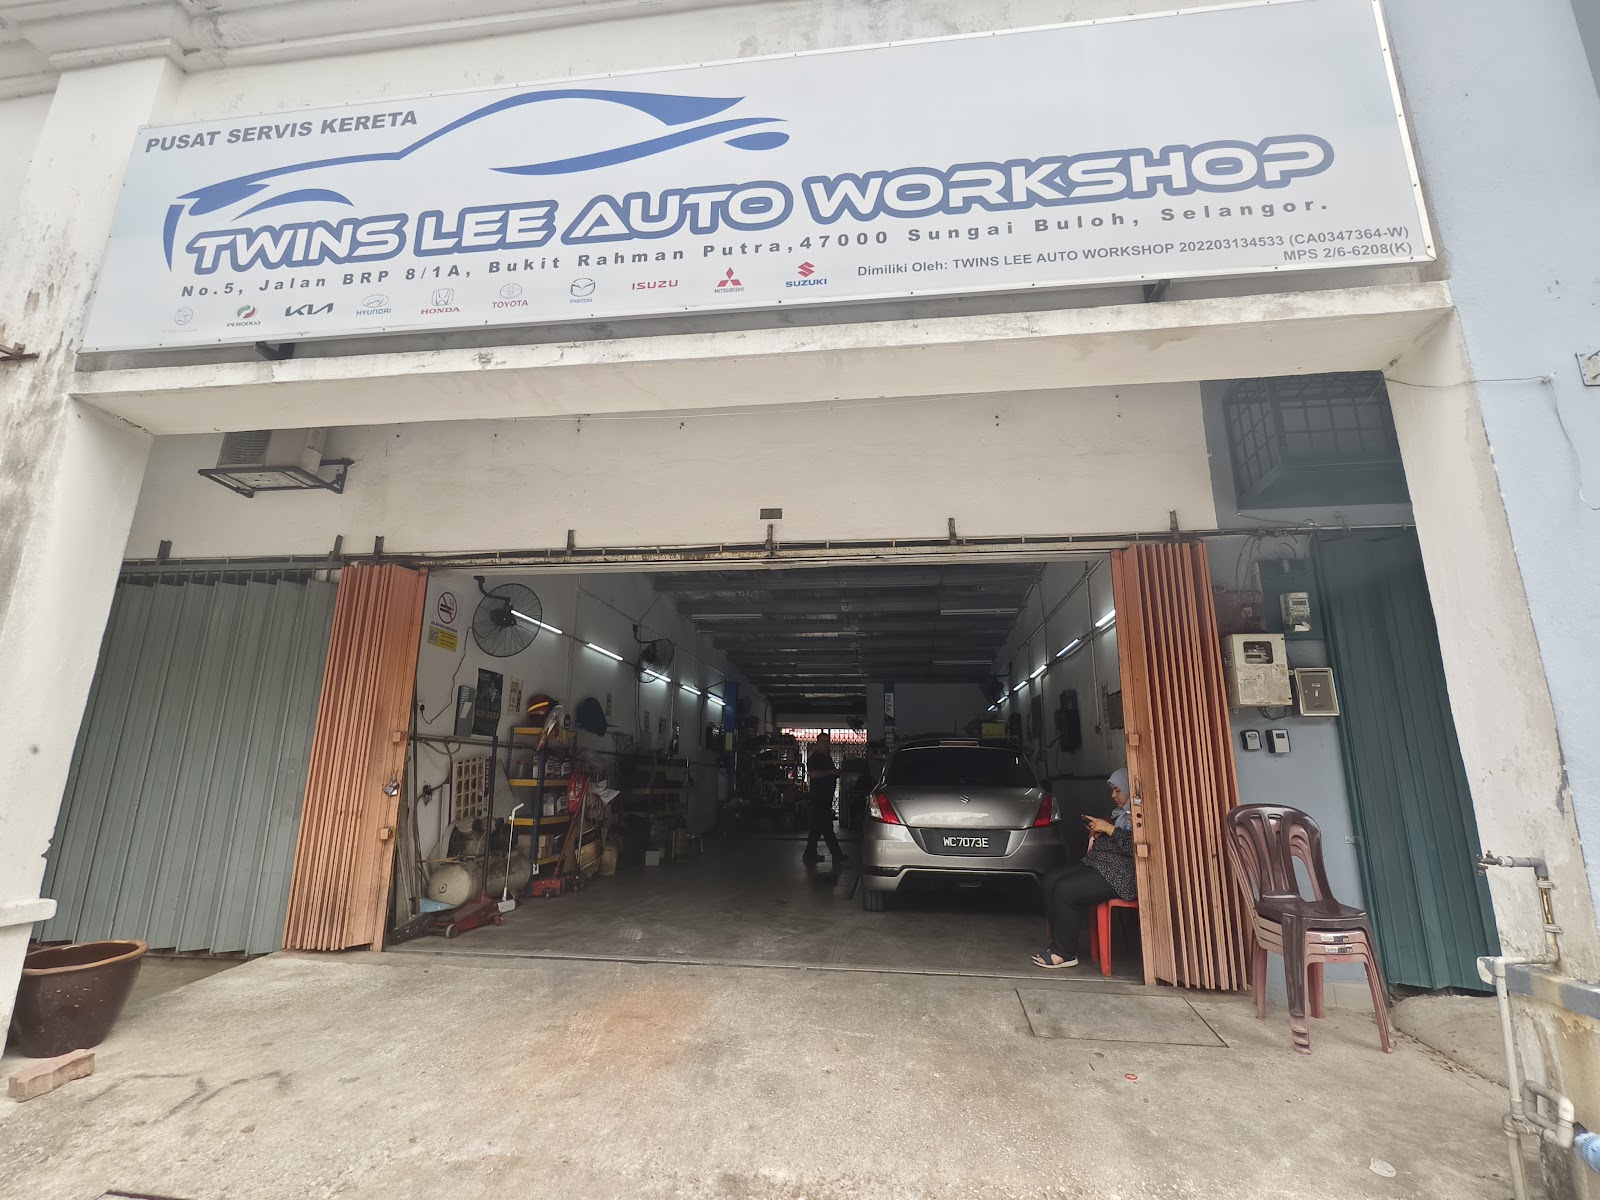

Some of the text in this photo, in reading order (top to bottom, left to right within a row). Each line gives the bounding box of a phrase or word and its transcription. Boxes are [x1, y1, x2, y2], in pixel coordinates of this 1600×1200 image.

[145, 110, 418, 153] PUSAT SERVIS KERETA
[185, 133, 1335, 276] TWINS LEE AUTO WORKSHOP
[181, 282, 244, 297] No.5,
[259, 278, 326, 291] Jalan
[342, 270, 389, 285] BRP
[405, 264, 471, 280] 8/1A,
[488, 257, 560, 273] Bukit
[577, 248, 684, 267] Rahman
[908, 221, 1014, 242] Sungai
[1034, 211, 1140, 232] Buloh,
[1161, 199, 1328, 221] Selangor.
[857, 226, 1410, 276] Dimiliki Oleh: TWINS LEE AUTO WORKSHOP 202203134533 (CA0347364-W)
[1283, 241, 1413, 262] MPS 2/6-6208(K)
[631, 280, 679, 290] ISUZU
[785, 278, 828, 288] SUZUKI
[284, 303, 334, 317] KIA
[492, 300, 528, 308] TOYOTA
[356, 308, 392, 316] HYUNDAI
[420, 307, 460, 315] HONDA
[943, 836, 989, 848] WC7073E
